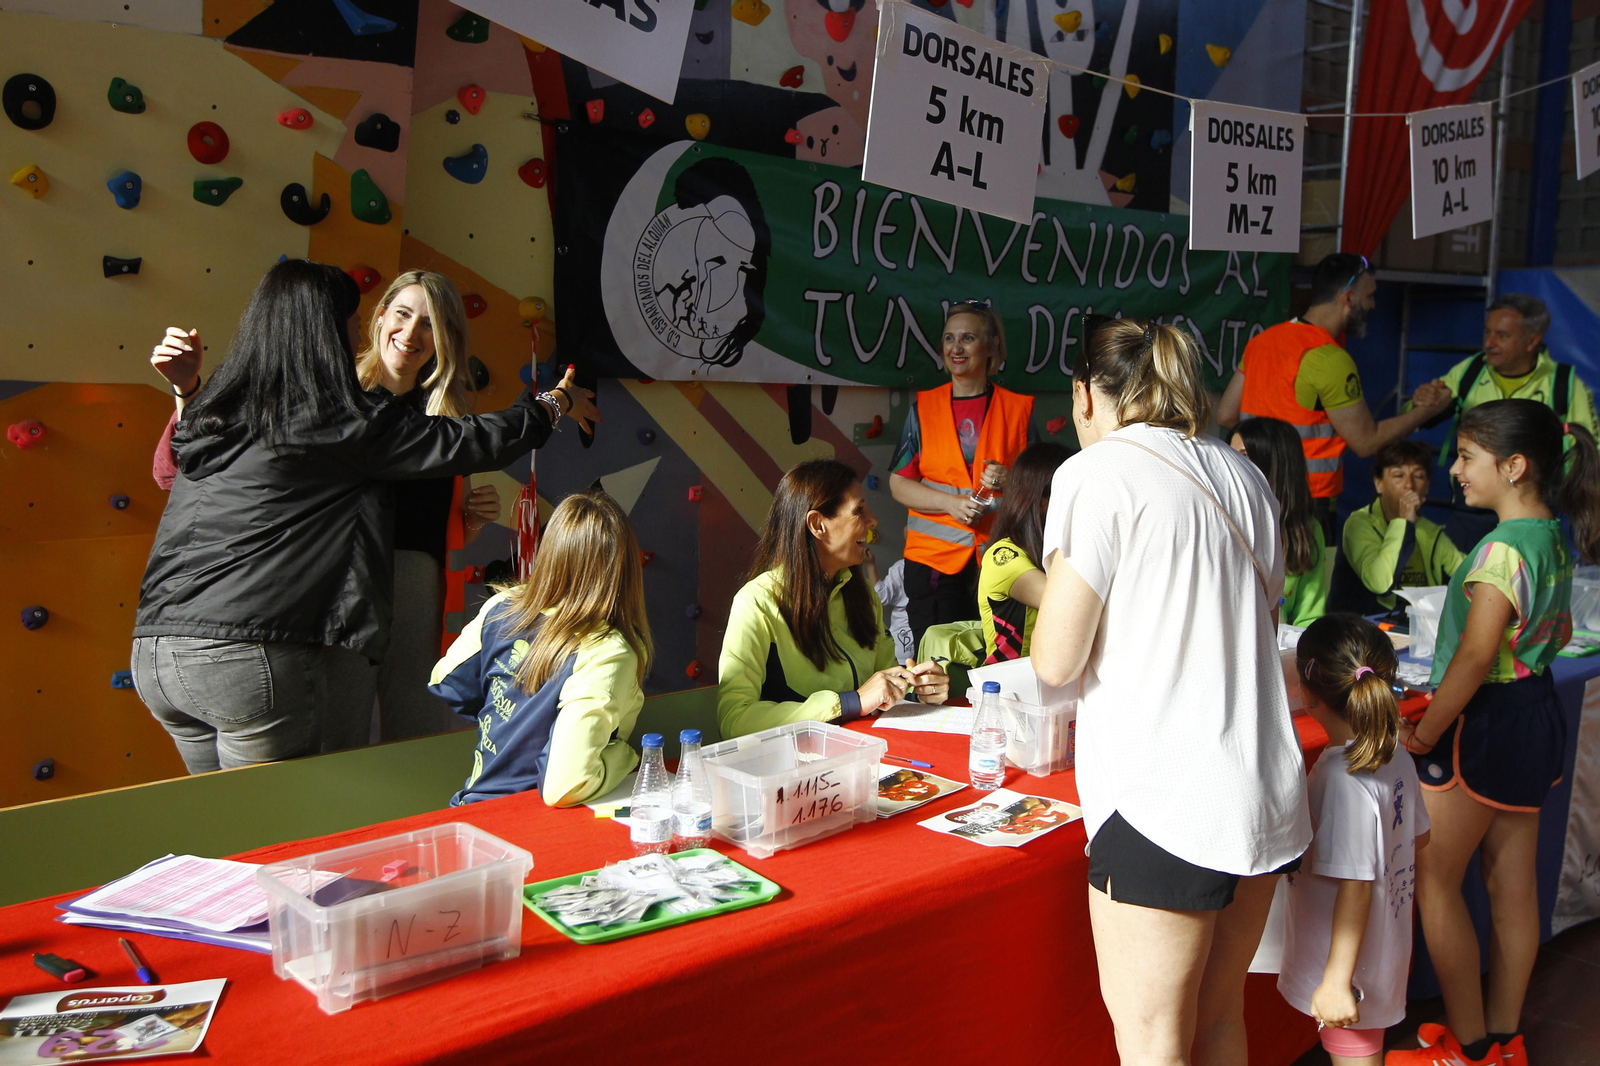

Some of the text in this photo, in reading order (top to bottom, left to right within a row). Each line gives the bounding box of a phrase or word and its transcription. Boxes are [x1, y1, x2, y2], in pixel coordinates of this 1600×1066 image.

[902, 22, 1035, 97] DORSALES
[925, 84, 1005, 145] 5 km
[1421, 116, 1485, 148] DORSALES
[1207, 116, 1295, 153] DORSALES
[929, 140, 988, 191] A-L
[1225, 161, 1277, 196] 5 km
[1432, 154, 1476, 185] 10 km
[1226, 202, 1274, 236] M-Z
[1441, 187, 1469, 218] A-L
[811, 179, 1269, 297] BIENVENIDOS AL
[636, 252, 653, 271] DEL
[636, 272, 669, 335] ESPARTANOS
[803, 274, 1006, 372] TÚN
[1024, 304, 1094, 377] DE
[791, 793, 844, 825] 1.176
